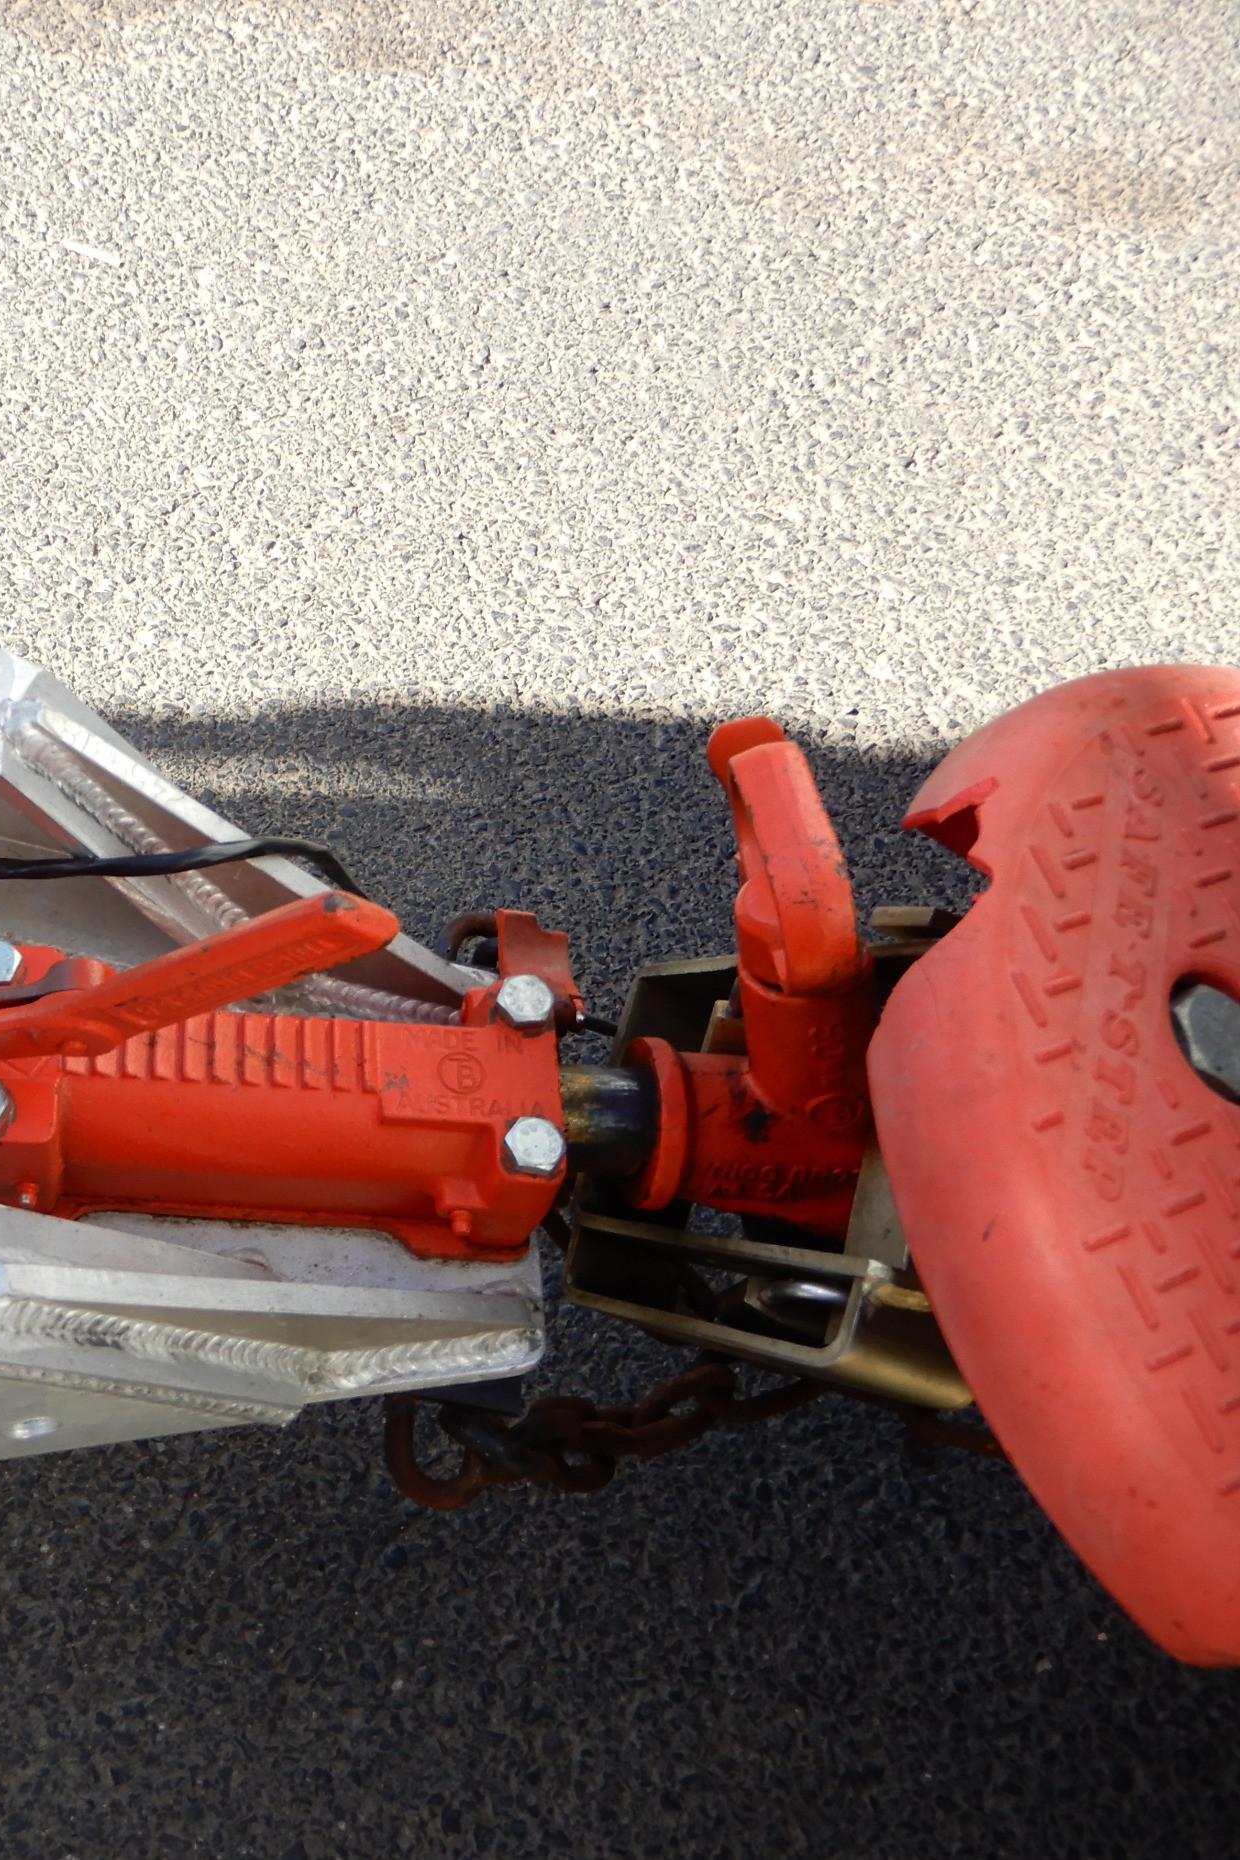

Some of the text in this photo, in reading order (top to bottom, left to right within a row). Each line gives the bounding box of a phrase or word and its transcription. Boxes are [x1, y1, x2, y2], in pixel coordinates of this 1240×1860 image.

[401, 1028, 524, 1055] MADE IN
[395, 1095, 544, 1118] AUSTRALIA
